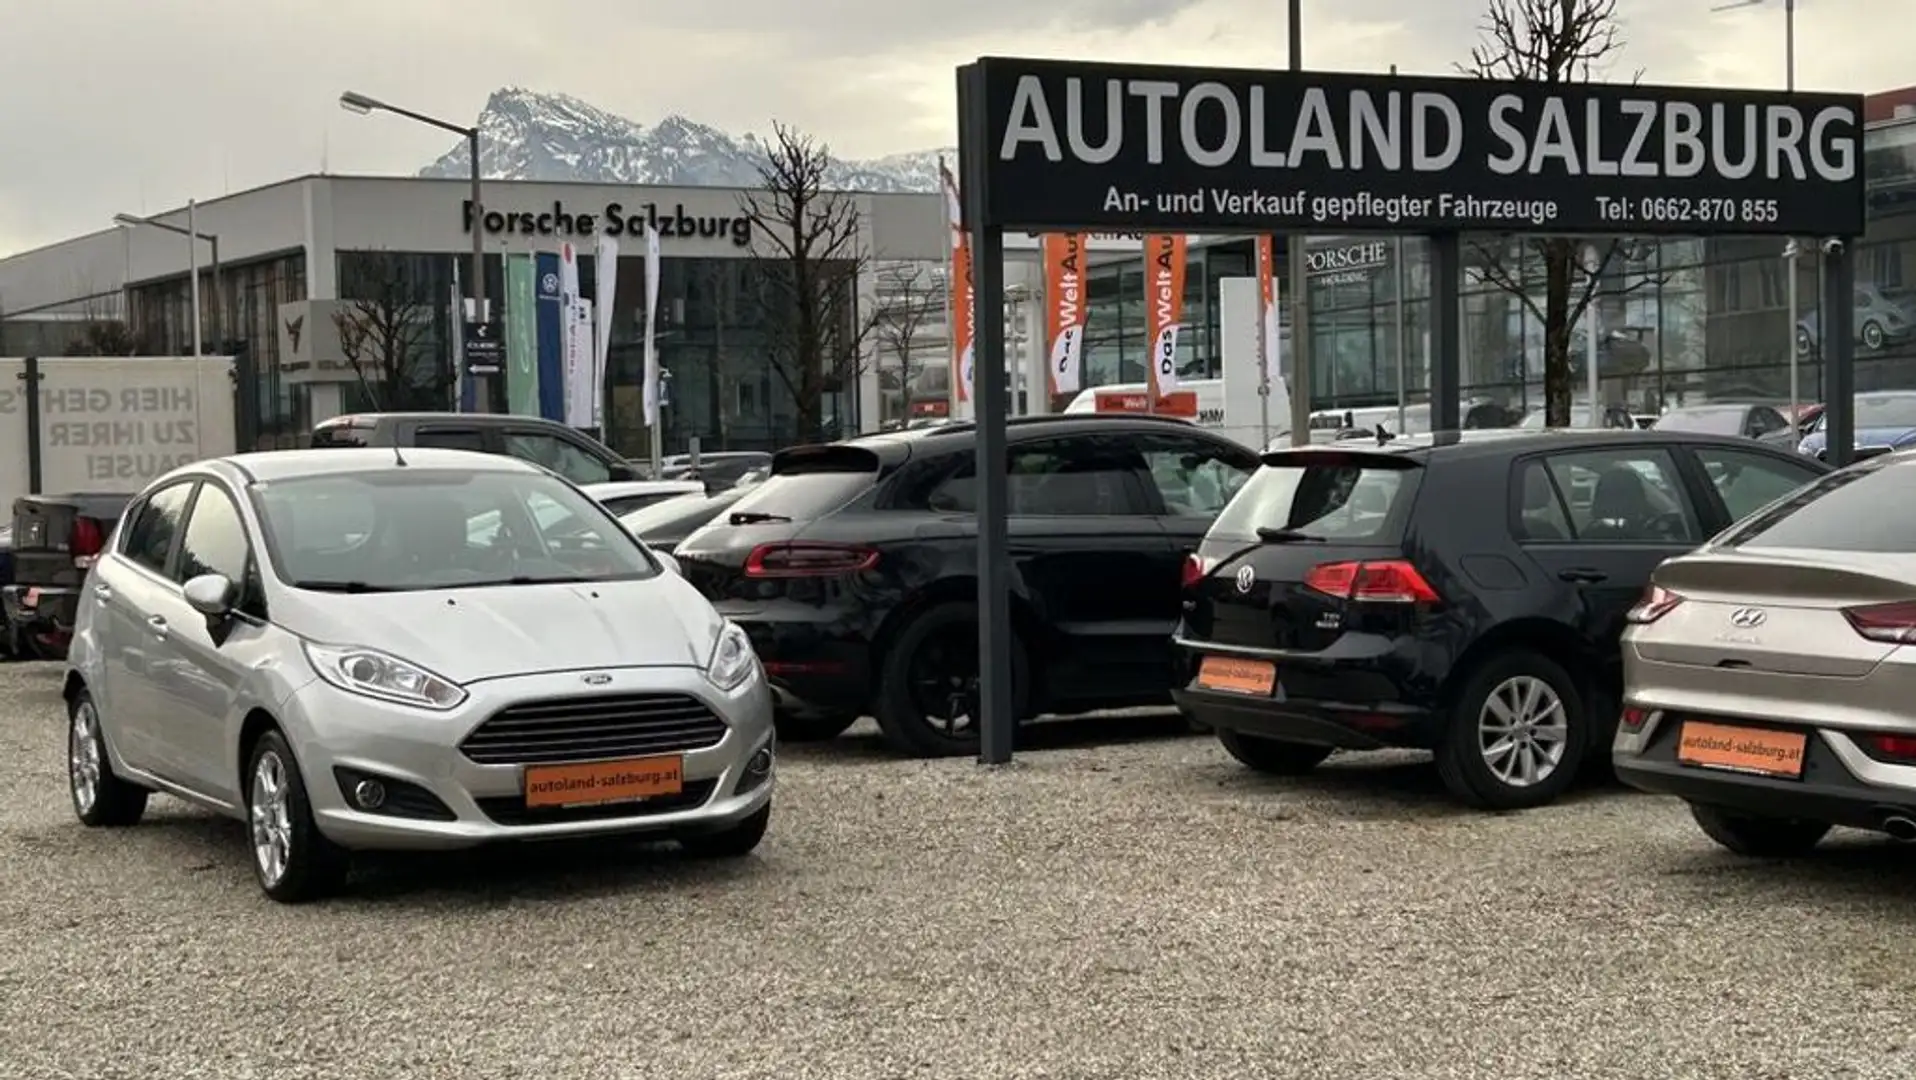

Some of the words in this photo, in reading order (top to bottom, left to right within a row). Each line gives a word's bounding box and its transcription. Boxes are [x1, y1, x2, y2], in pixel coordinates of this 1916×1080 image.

[999, 75, 1464, 172] AUTOLAND
[1487, 93, 1856, 182] SALZBURG
[1104, 186, 1150, 212] An-
[1158, 189, 1204, 214] und
[1211, 190, 1306, 215] Verkauf
[1312, 191, 1431, 222] gepflegter
[1439, 193, 1558, 223] Fahrzeuge
[1596, 196, 1635, 221] Tel:
[1642, 198, 1736, 222] 0662-870
[1742, 200, 1779, 222] 855
[463, 200, 595, 235] Porsche
[605, 202, 751, 246] Salzburg
[1683, 735, 1801, 761] autoland-salzburg.at
[530, 769, 678, 793] autoland-salzburg.at
